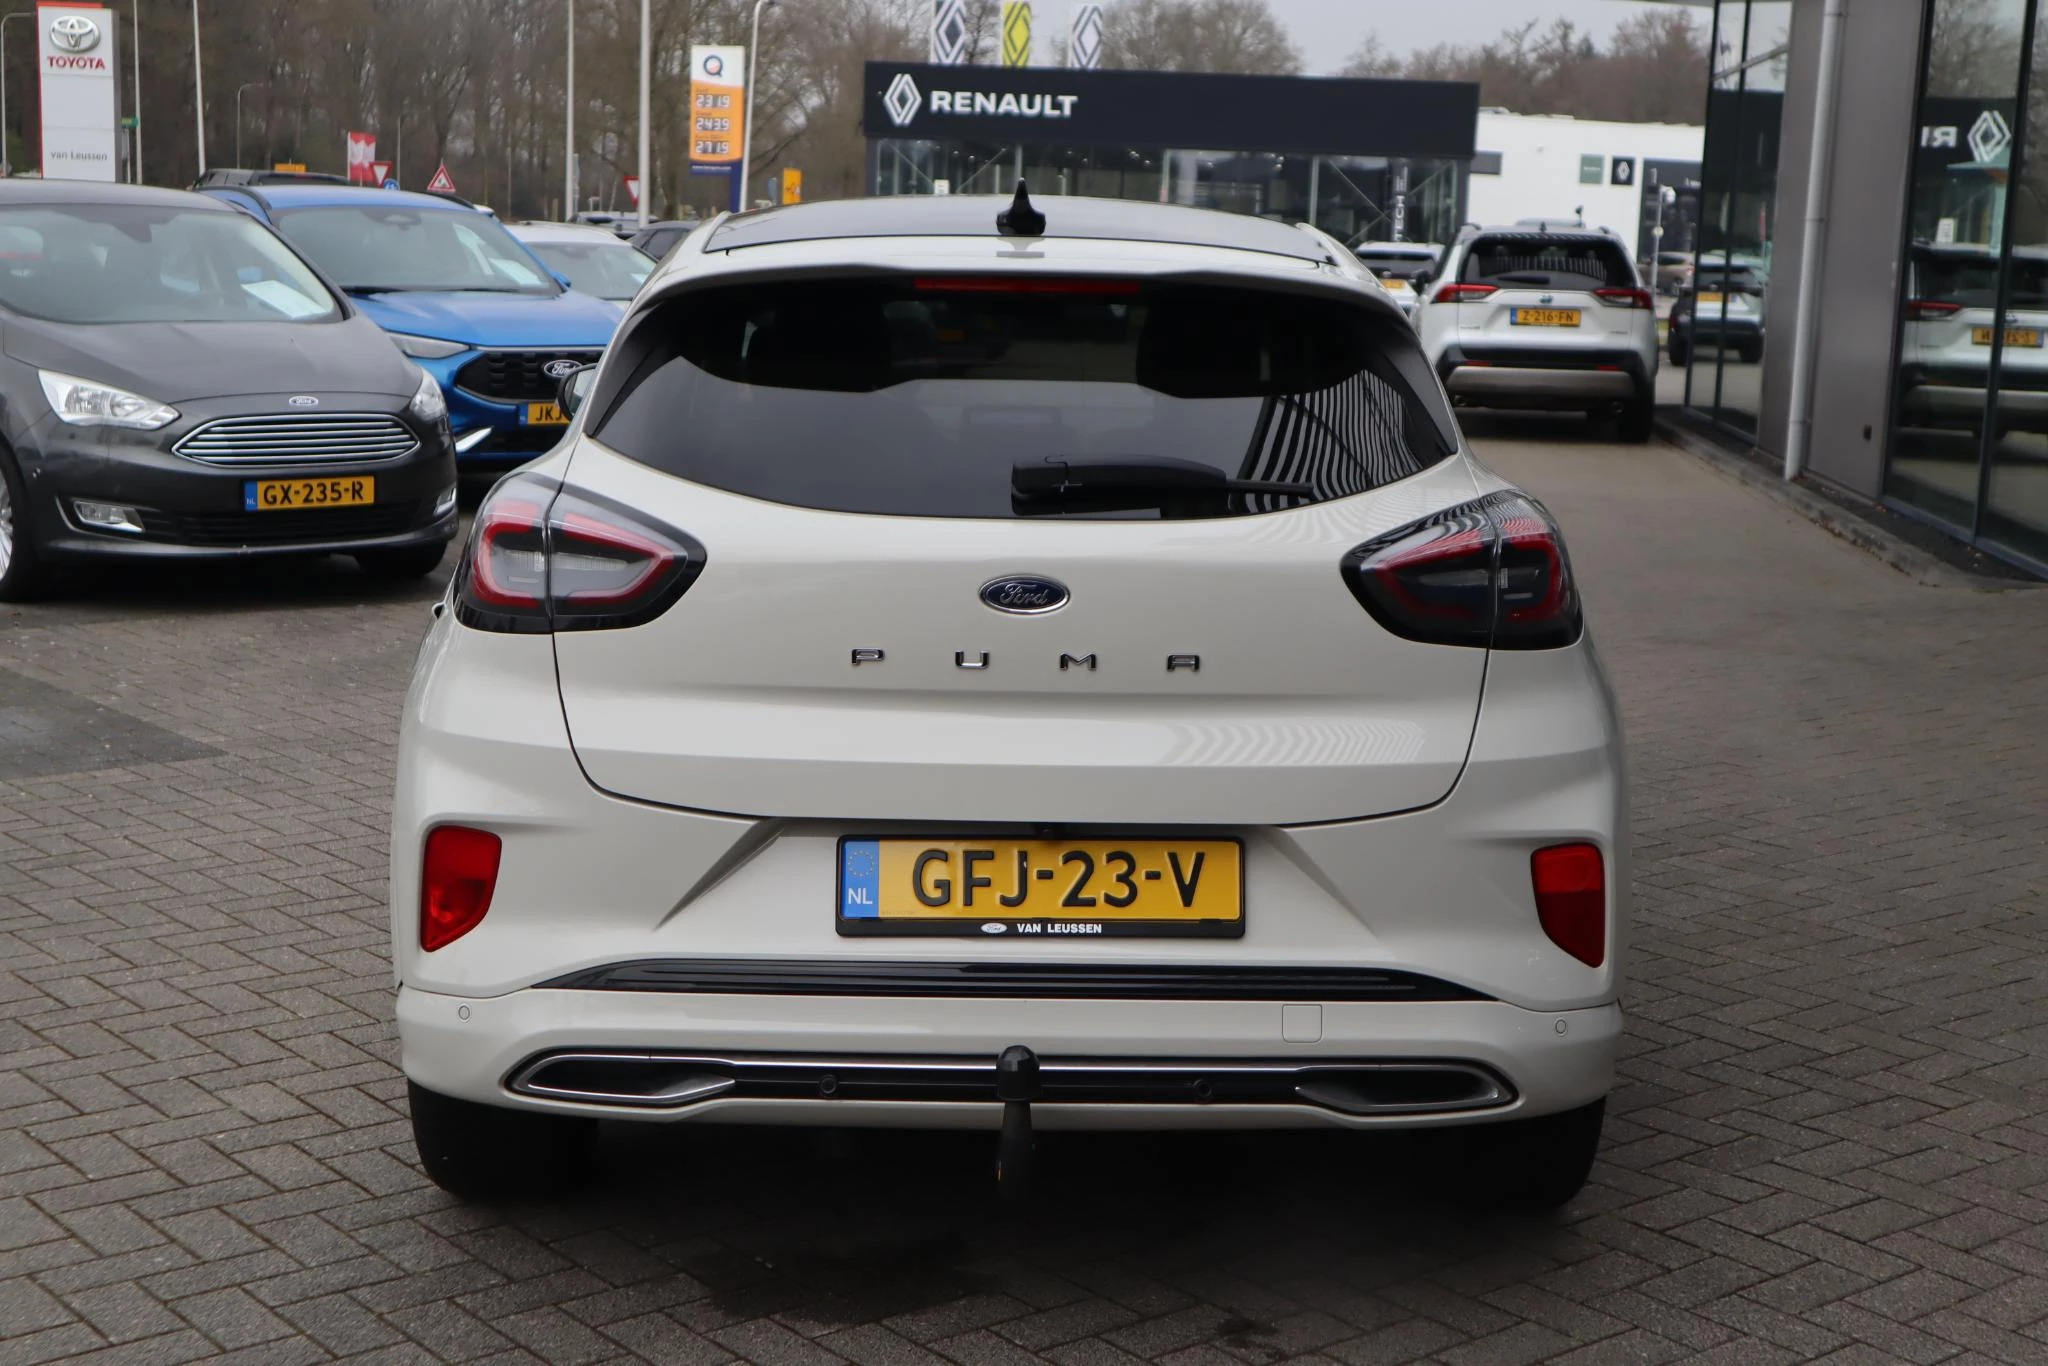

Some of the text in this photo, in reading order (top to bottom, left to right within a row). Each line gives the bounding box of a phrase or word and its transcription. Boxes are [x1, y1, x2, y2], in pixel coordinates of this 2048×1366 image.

[47, 56, 106, 70] TOYOTA
[931, 91, 1078, 116] RENAULT
[51, 151, 68, 160] van
[263, 480, 364, 506] GX-235-R
[999, 581, 1049, 607] Ford
[851, 648, 1202, 671] PUMA
[912, 849, 1205, 908] GFJ-23-V
[847, 887, 873, 905] NL
[1017, 923, 1042, 933] VAN
[1047, 923, 1102, 934] LEUSSEN
